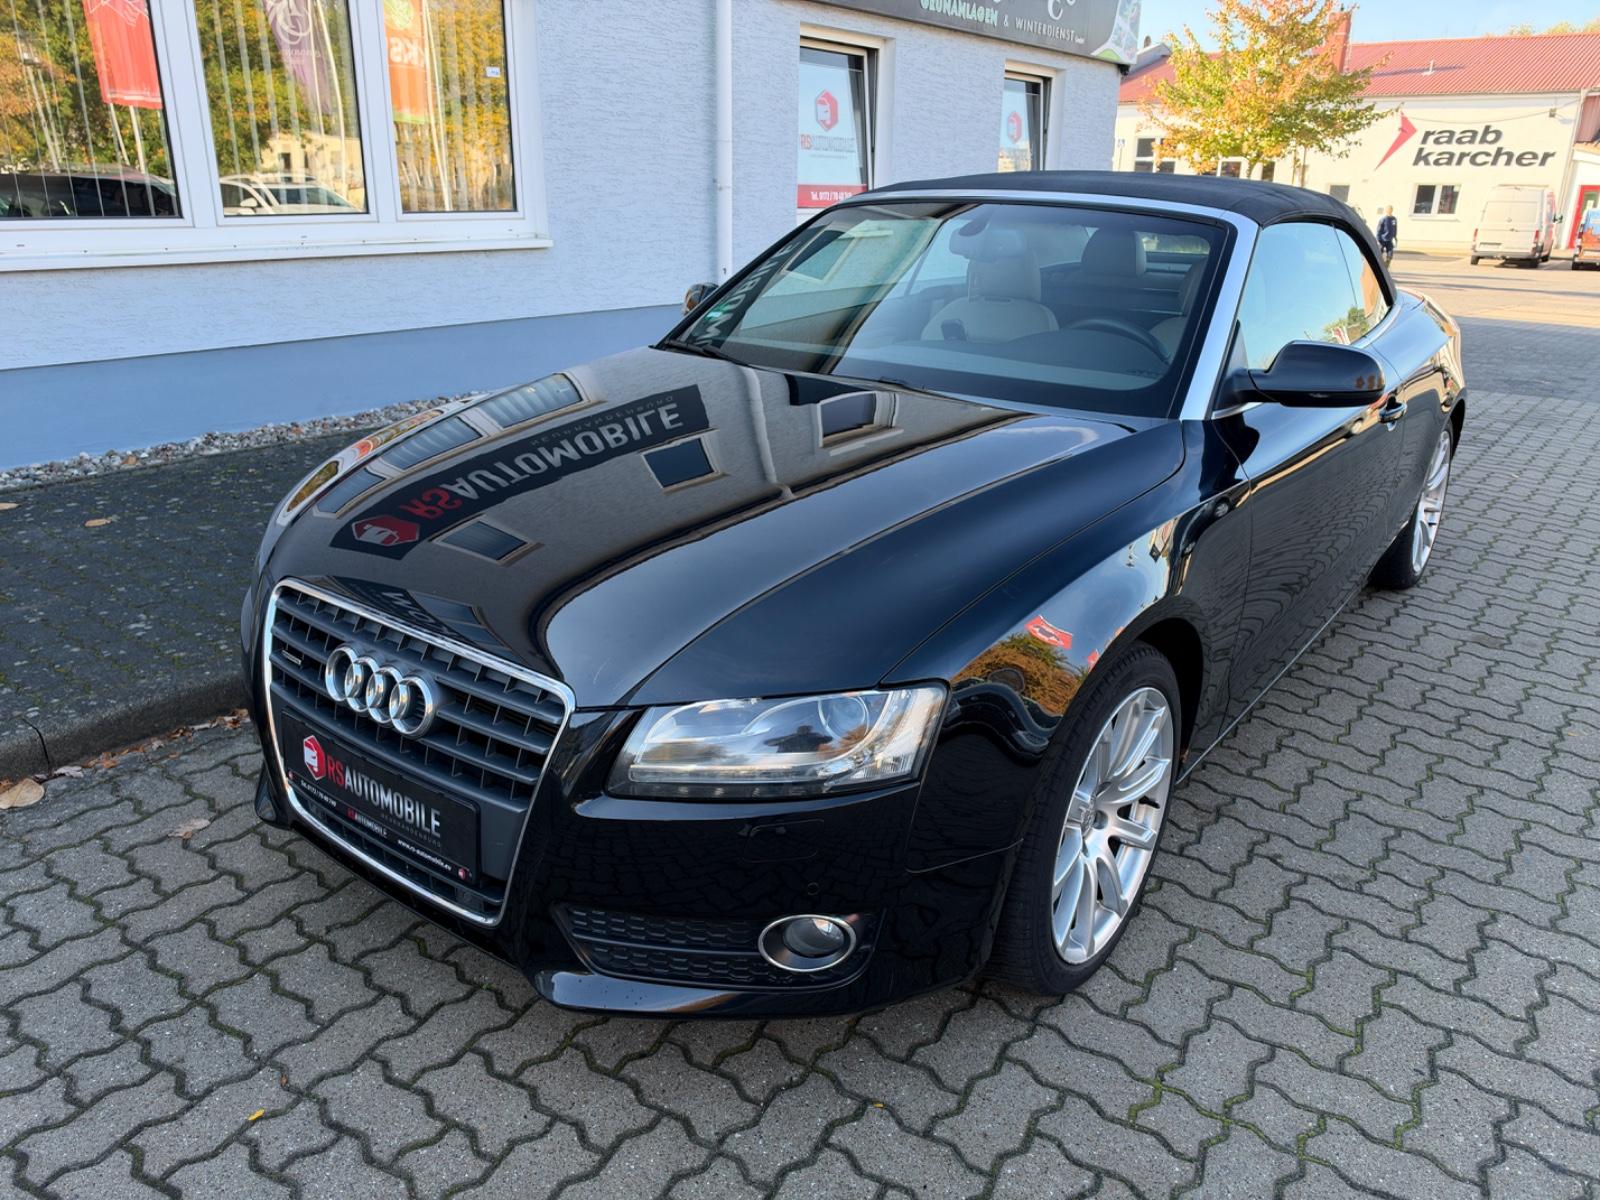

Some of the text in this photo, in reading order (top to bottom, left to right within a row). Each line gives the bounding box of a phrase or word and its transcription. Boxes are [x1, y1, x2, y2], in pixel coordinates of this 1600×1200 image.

[1015, 17, 1075, 42] WINTERDIENST
[1420, 125, 1503, 145] raab
[1412, 147, 1556, 167] karcher
